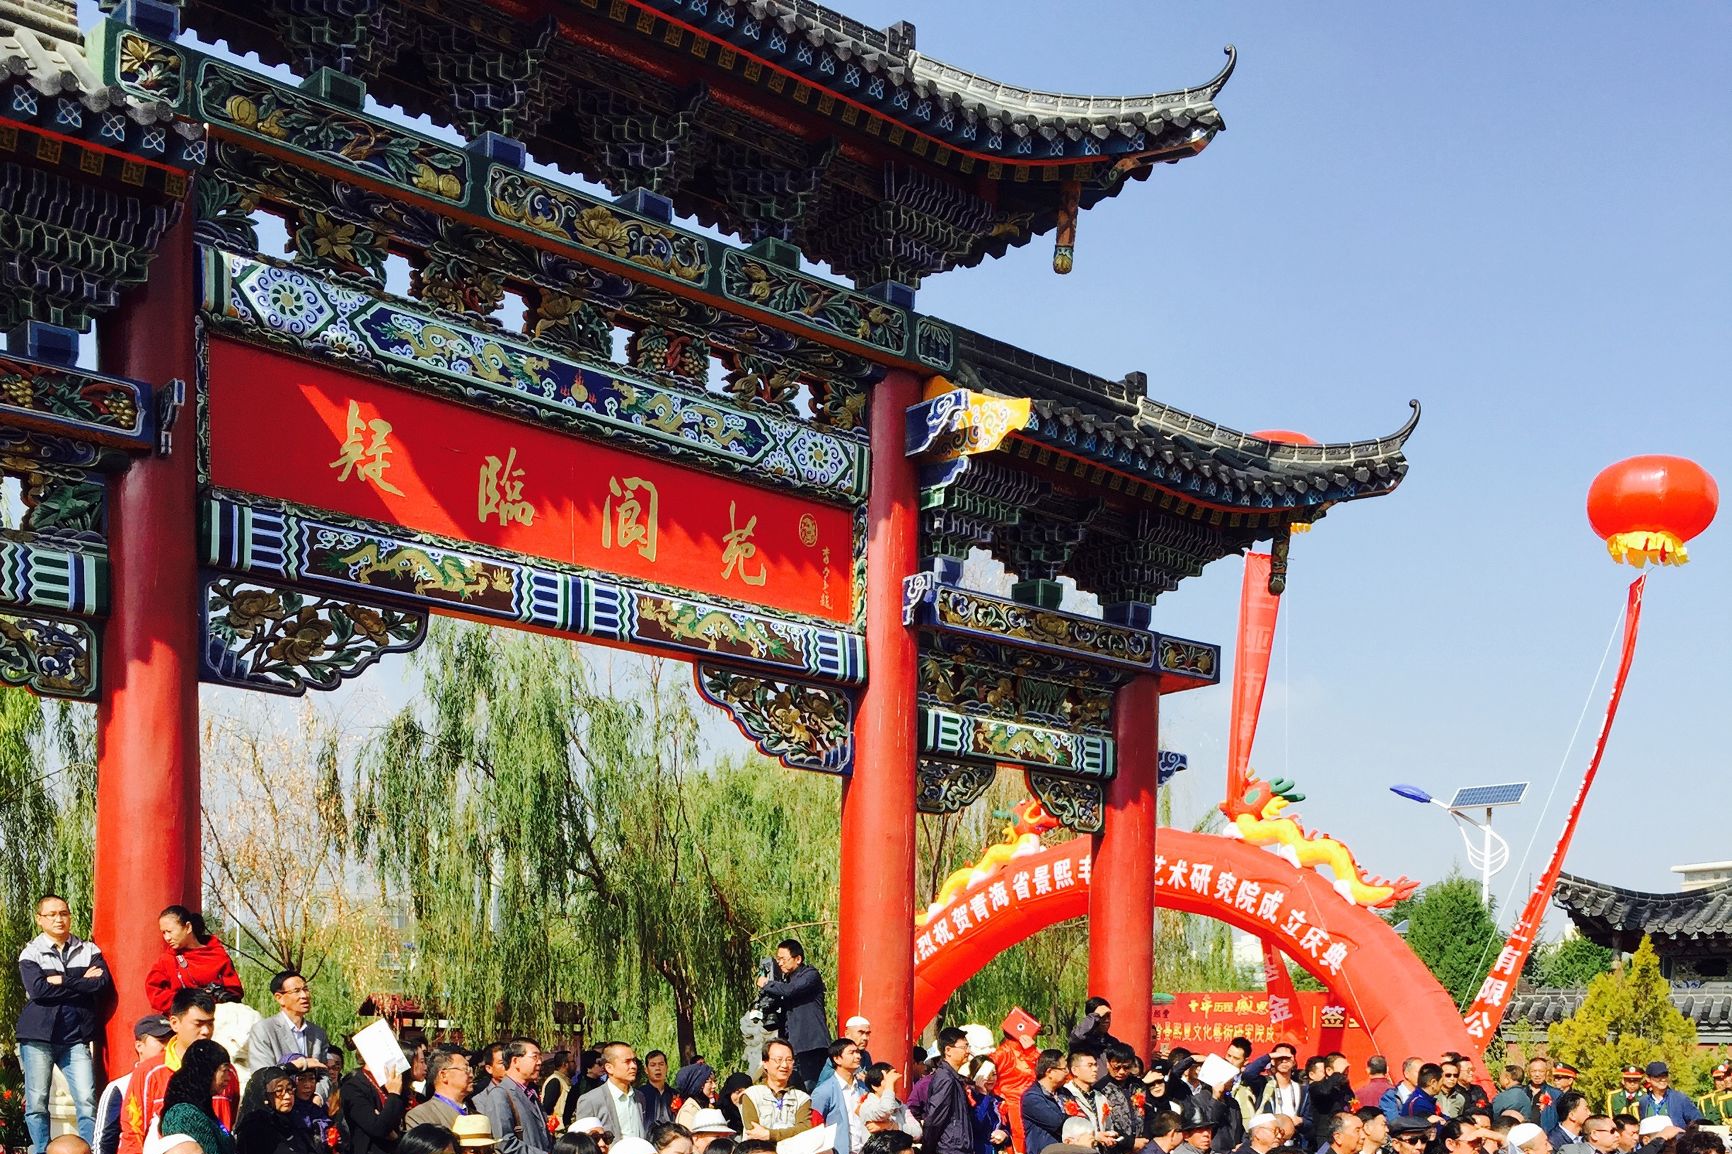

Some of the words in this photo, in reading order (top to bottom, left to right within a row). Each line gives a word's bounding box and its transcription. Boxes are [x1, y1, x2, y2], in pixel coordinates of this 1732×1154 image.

[914, 854, 1091, 966] 烈祝贺青海省景熙丰
